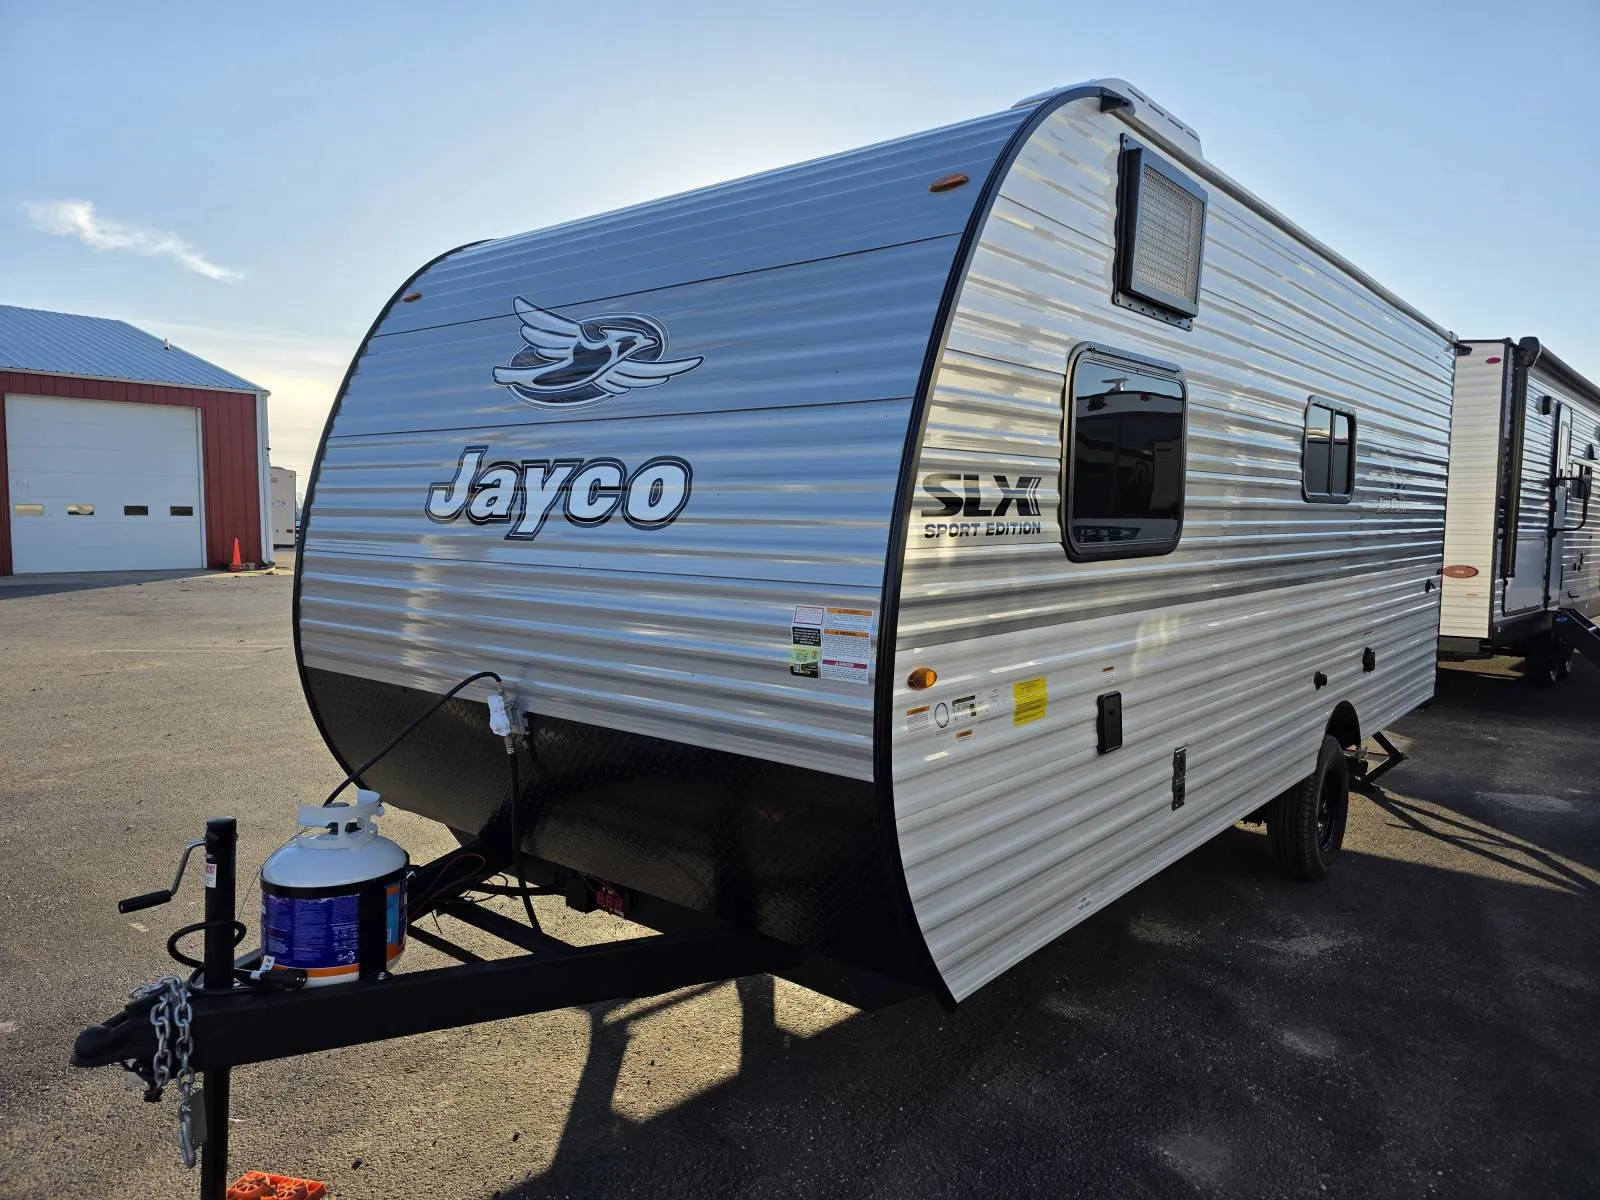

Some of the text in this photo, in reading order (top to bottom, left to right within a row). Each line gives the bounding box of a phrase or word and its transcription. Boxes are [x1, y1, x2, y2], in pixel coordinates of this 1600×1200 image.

[425, 445, 693, 541] Jayco
[921, 473, 1041, 517] SLX
[924, 521, 1040, 538] SPORT EDITION
